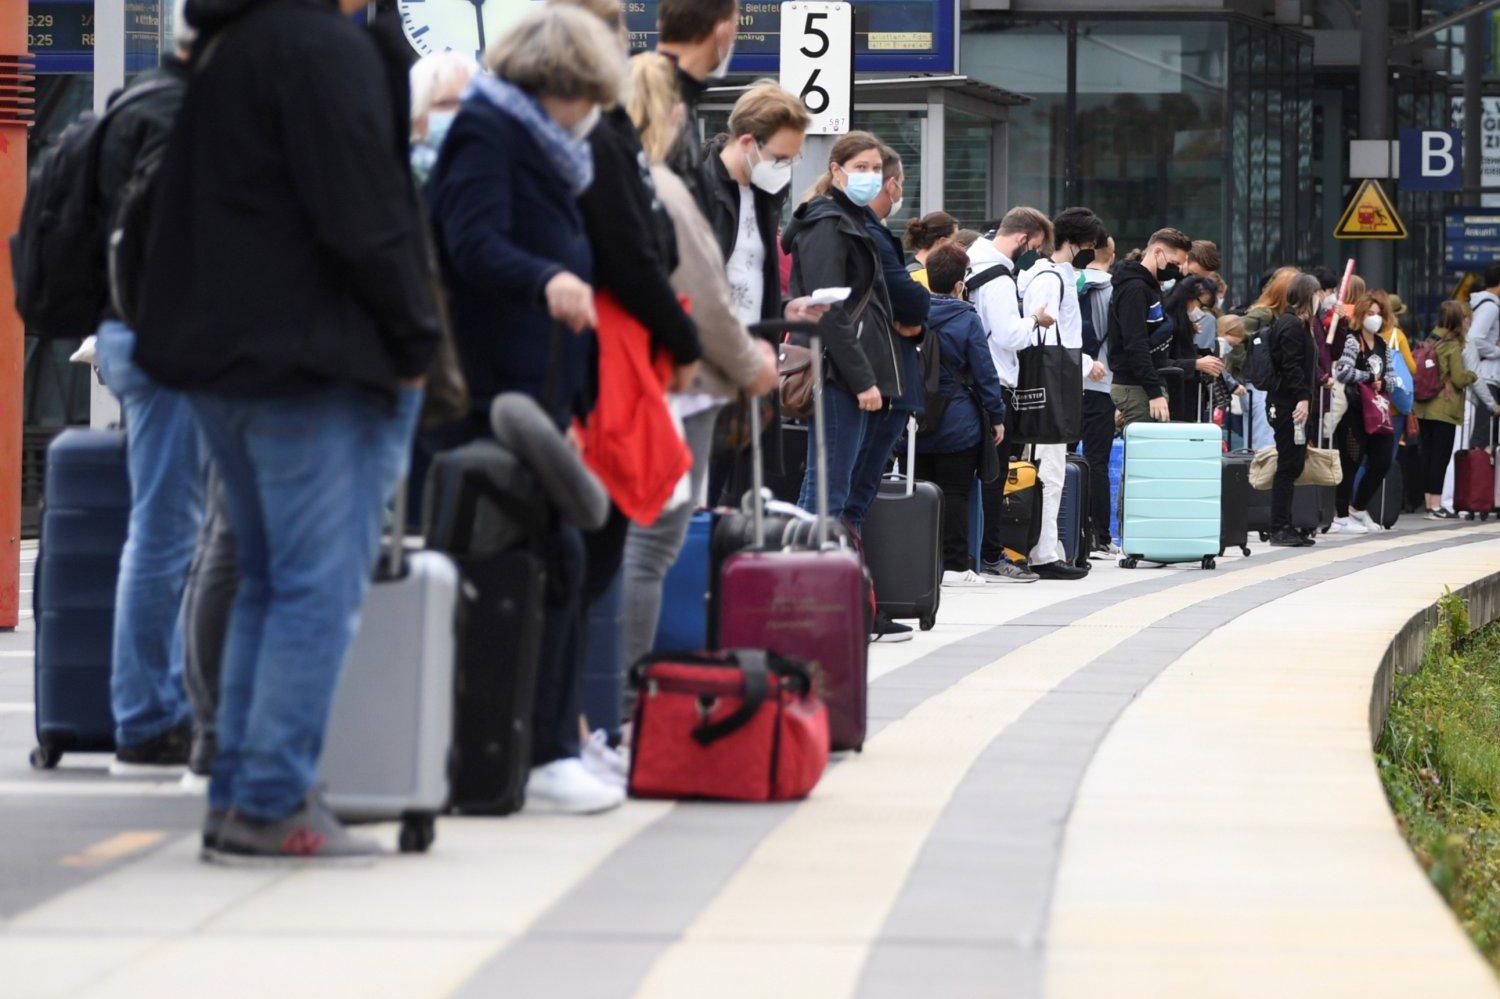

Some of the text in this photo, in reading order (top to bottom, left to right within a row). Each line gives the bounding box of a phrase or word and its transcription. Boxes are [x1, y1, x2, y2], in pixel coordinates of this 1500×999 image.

[28, 15, 54, 26] 9:29
[745, 3, 780, 13] Bielefel
[28, 34, 53, 45] 0:25
[800, 13, 829, 58] 5
[800, 69, 829, 114] 6
[1420, 131, 1454, 177] B
